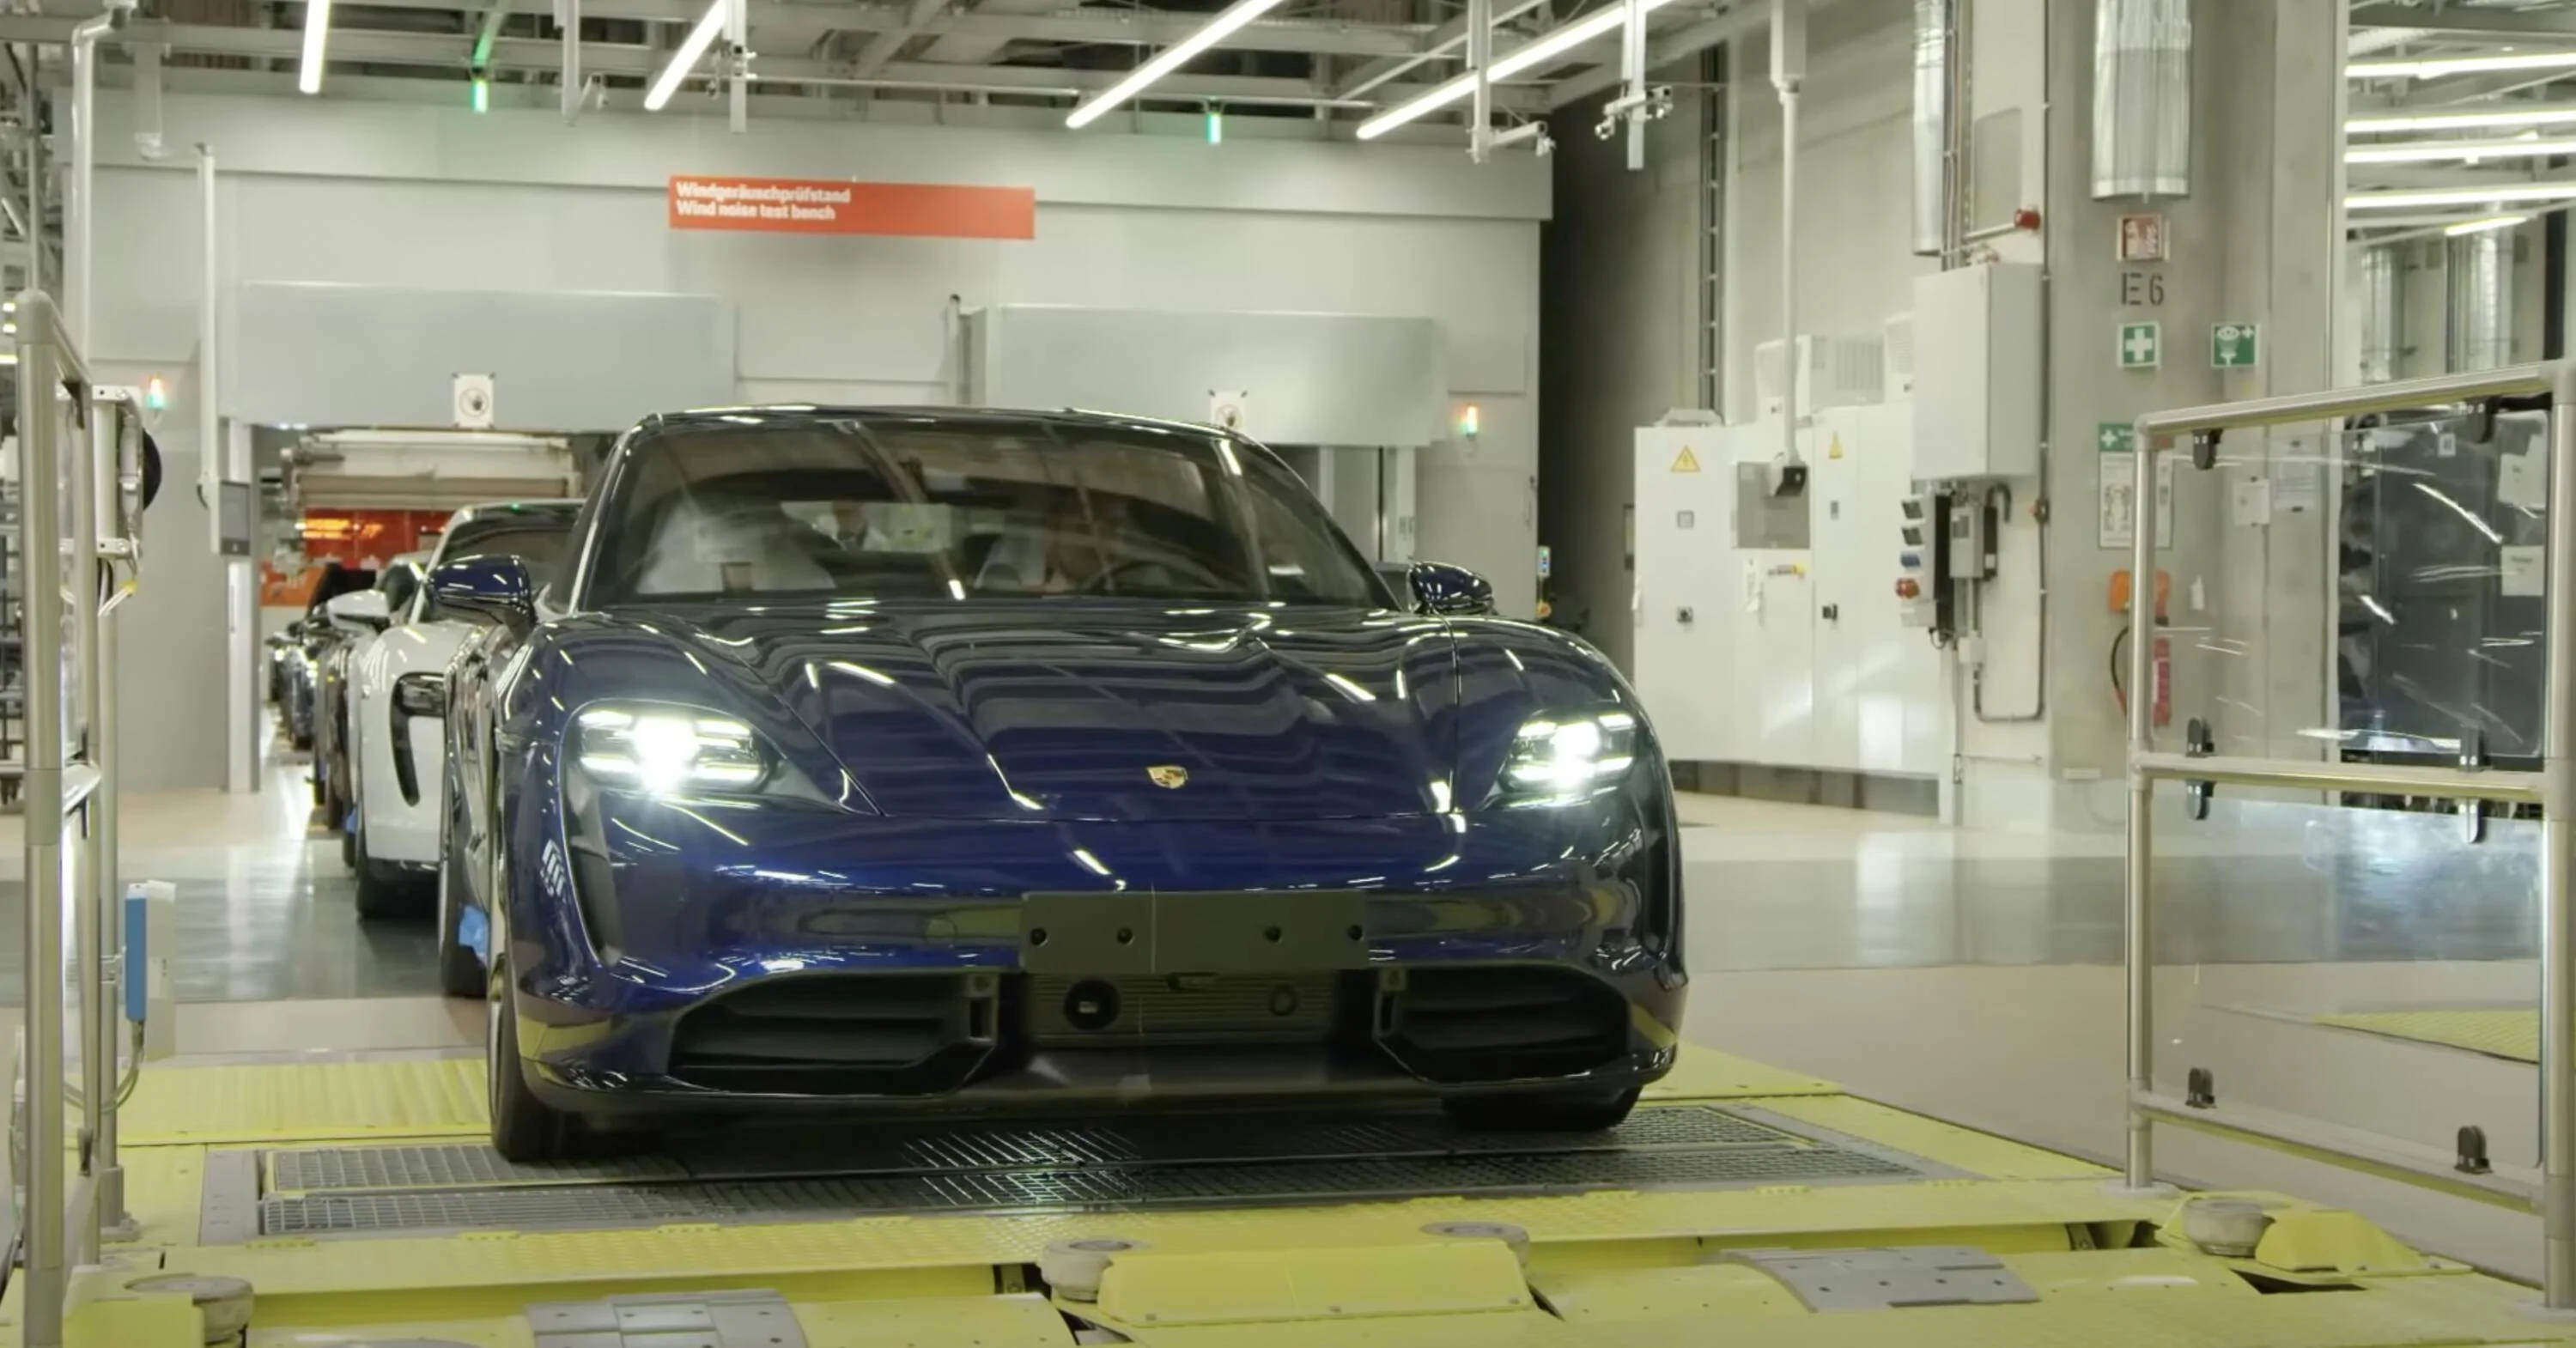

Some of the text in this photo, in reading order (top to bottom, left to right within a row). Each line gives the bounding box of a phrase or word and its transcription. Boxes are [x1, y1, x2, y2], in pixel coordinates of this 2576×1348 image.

[676, 181, 851, 203] Windgeräuschprüfstand
[676, 199, 836, 220] Wind noise test bench
